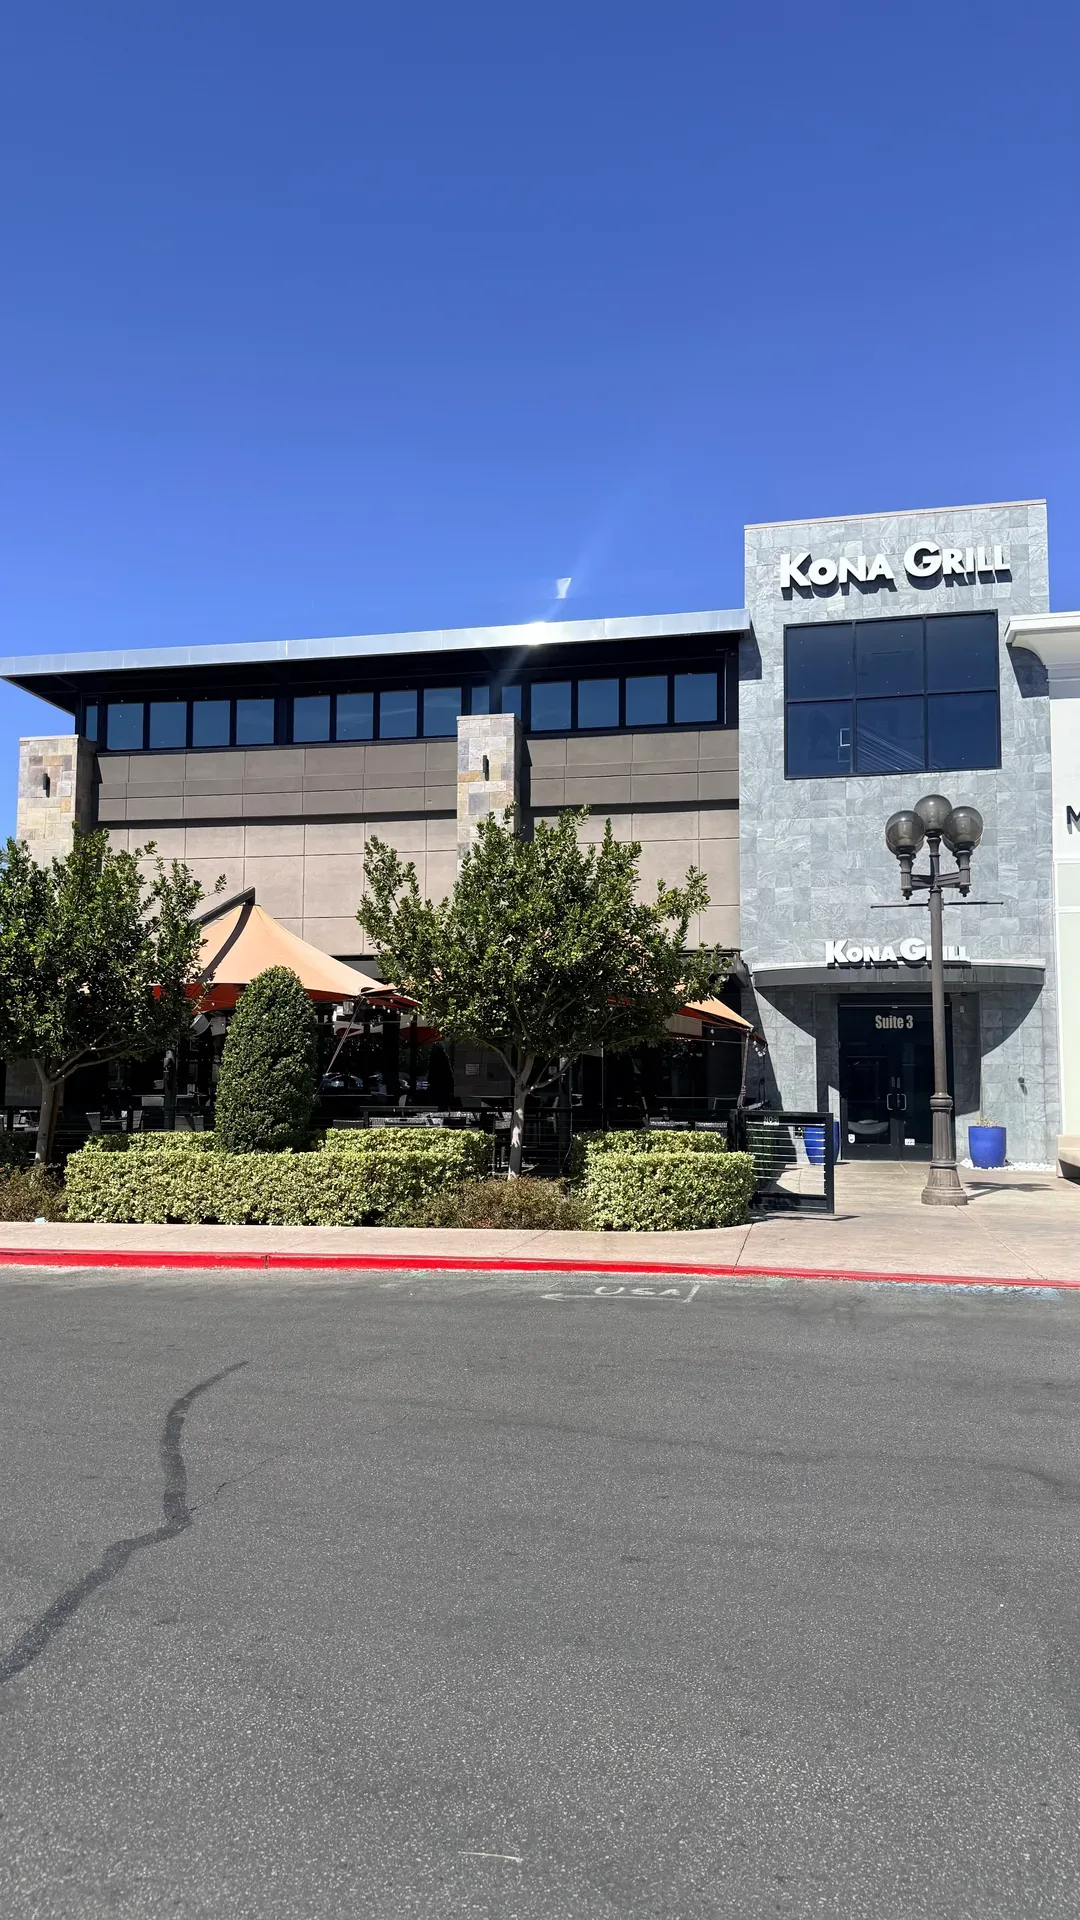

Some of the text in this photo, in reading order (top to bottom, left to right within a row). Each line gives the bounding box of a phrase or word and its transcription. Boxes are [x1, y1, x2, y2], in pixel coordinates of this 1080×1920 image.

[780, 540, 1010, 588] KONA GRILL
[825, 940, 898, 963] KONA
[875, 1015, 914, 1029] Suite 3
[594, 1286, 680, 1296] USA
